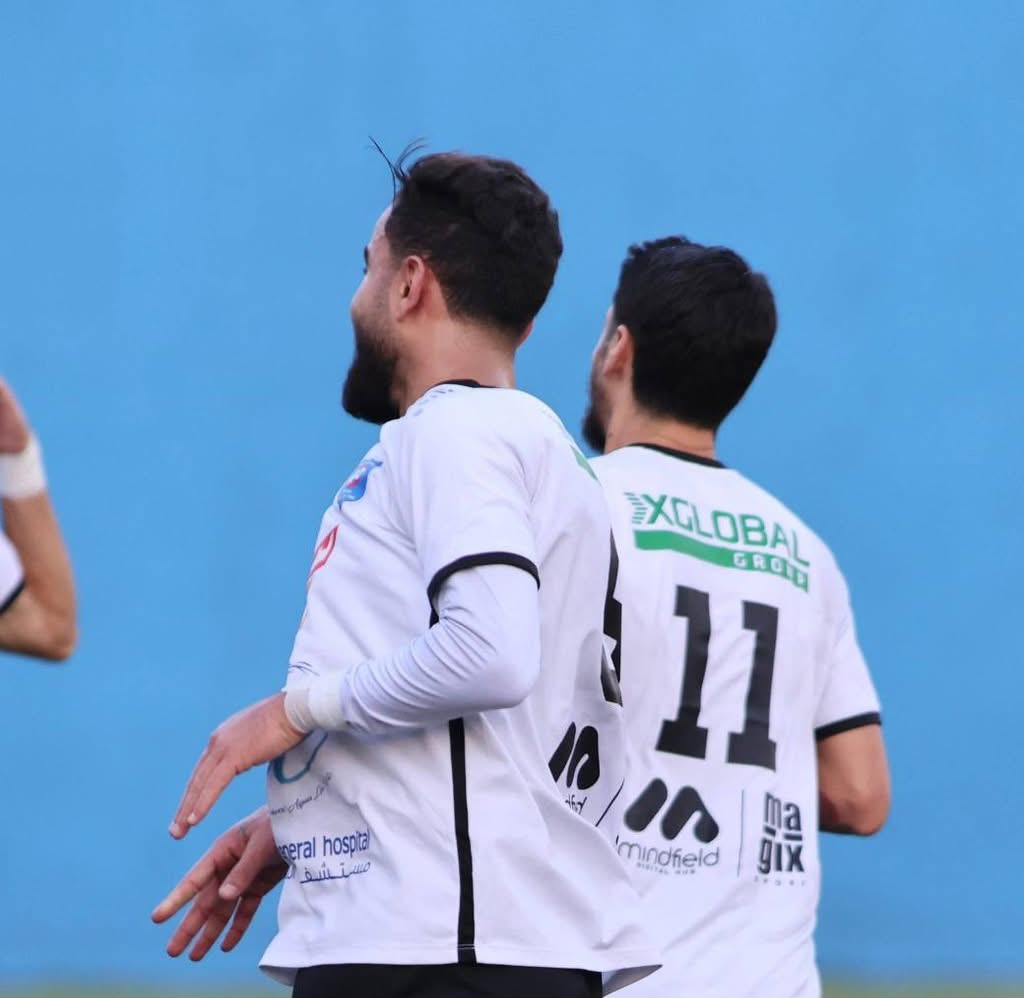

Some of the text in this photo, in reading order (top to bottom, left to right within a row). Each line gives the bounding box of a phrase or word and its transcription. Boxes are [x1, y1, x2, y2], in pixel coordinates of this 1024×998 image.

[655, 584, 779, 772] 11
[323, 828, 369, 858] hospital
[617, 841, 719, 868] mindfield
